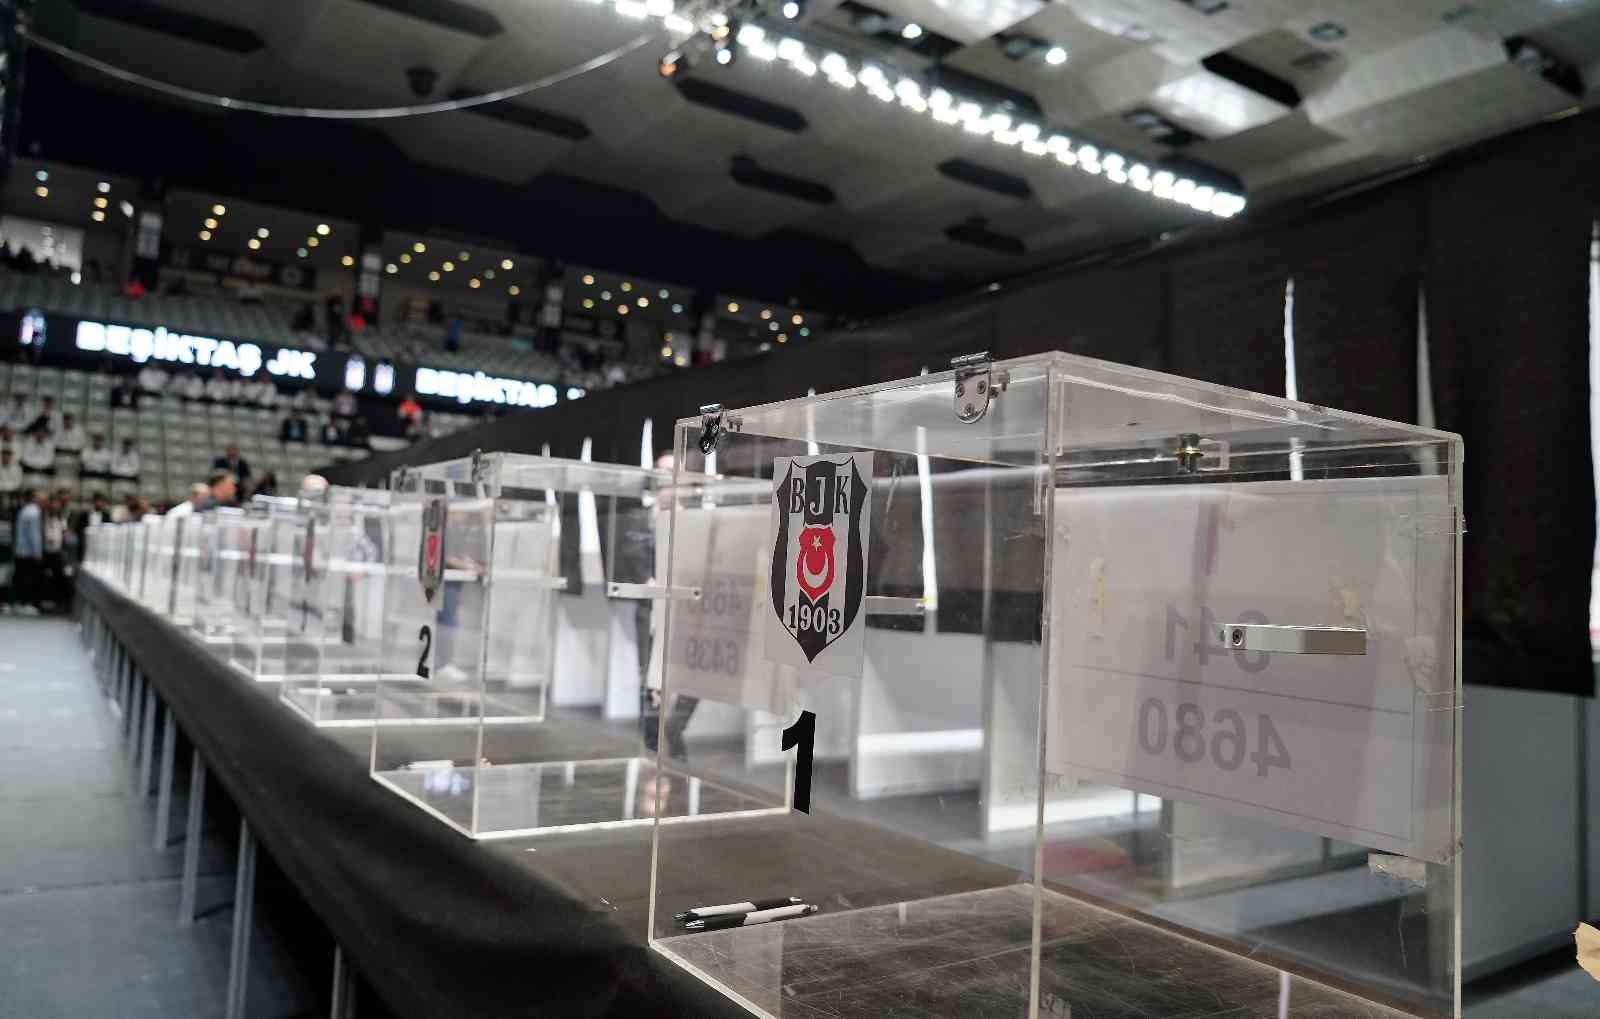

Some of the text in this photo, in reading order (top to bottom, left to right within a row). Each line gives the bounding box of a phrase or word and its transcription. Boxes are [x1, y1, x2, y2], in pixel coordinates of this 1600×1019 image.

[266, 348, 317, 380] JK
[789, 475, 850, 515] BJK
[788, 603, 842, 636] 1903
[416, 625, 432, 679] 2
[781, 710, 817, 816] 1
